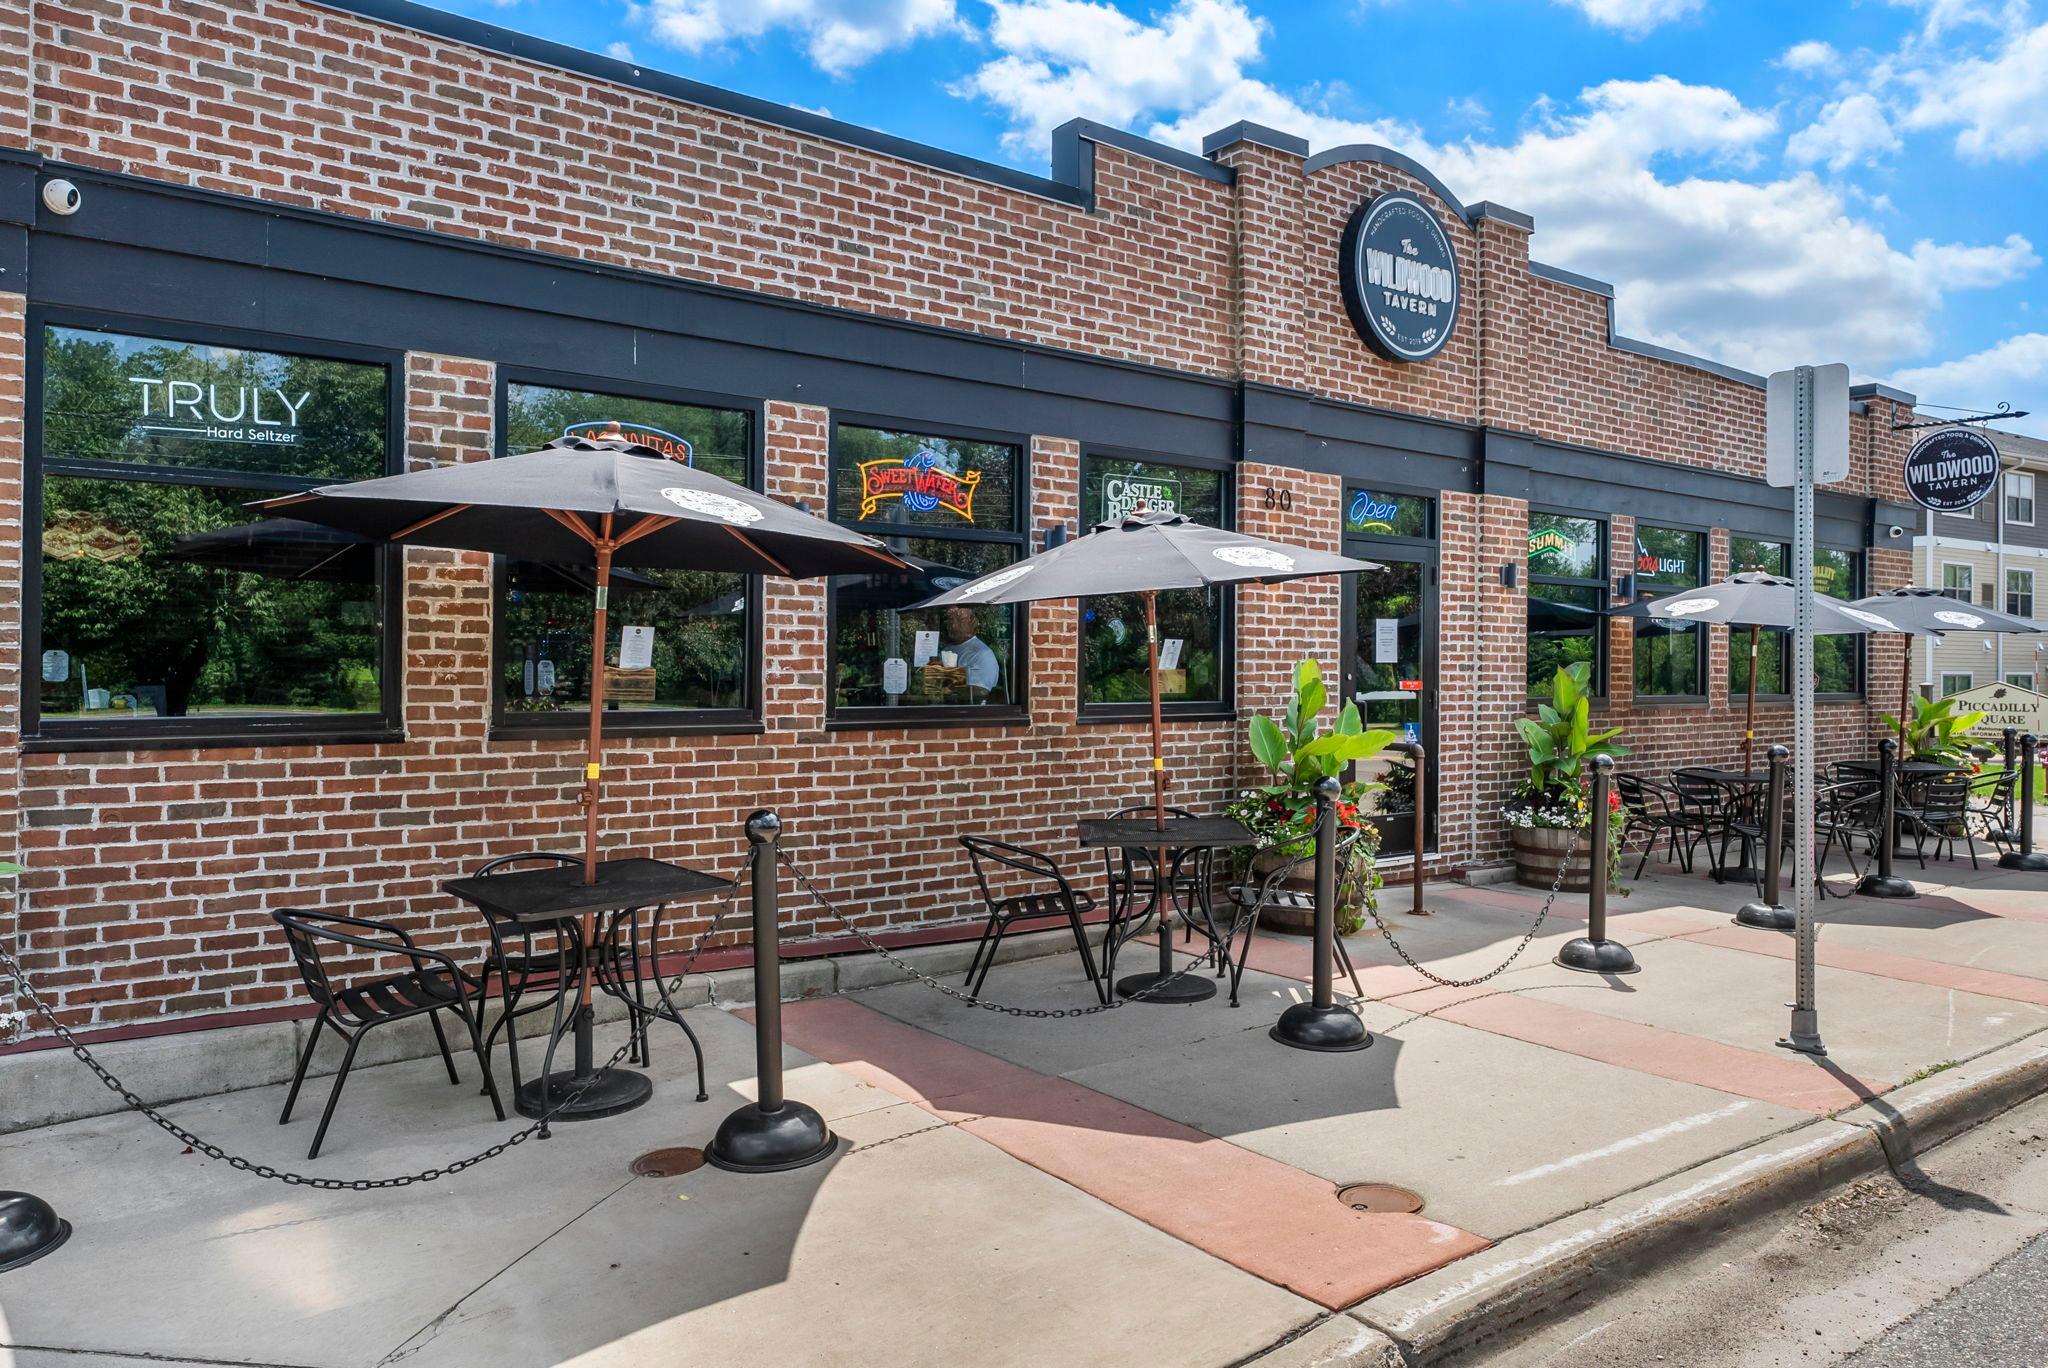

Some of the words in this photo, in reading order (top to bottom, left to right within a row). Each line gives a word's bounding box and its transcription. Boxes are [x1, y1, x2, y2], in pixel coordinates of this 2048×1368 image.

[1401, 238, 1419, 256] The
[1366, 247, 1452, 303] WILDWOOD
[1383, 291, 1437, 317] TAVERN
[128, 377, 310, 427] TRULY
[207, 426, 243, 439] Hard
[248, 428, 296, 443] Seltzer
[1912, 433, 1946, 460] HANDCRAFTED
[1941, 450, 1956, 459] The
[1909, 455, 1994, 484] WILDWOOD
[1107, 480, 1162, 501] CASTLE
[1928, 477, 1978, 491] TAVERN
[1265, 487, 1291, 511] 80
[1351, 492, 1397, 525] Open
[1529, 533, 1573, 557] SUMMIT
[1659, 558, 1686, 573] LIGHT
[1958, 700, 2038, 713] PICCADILLY
